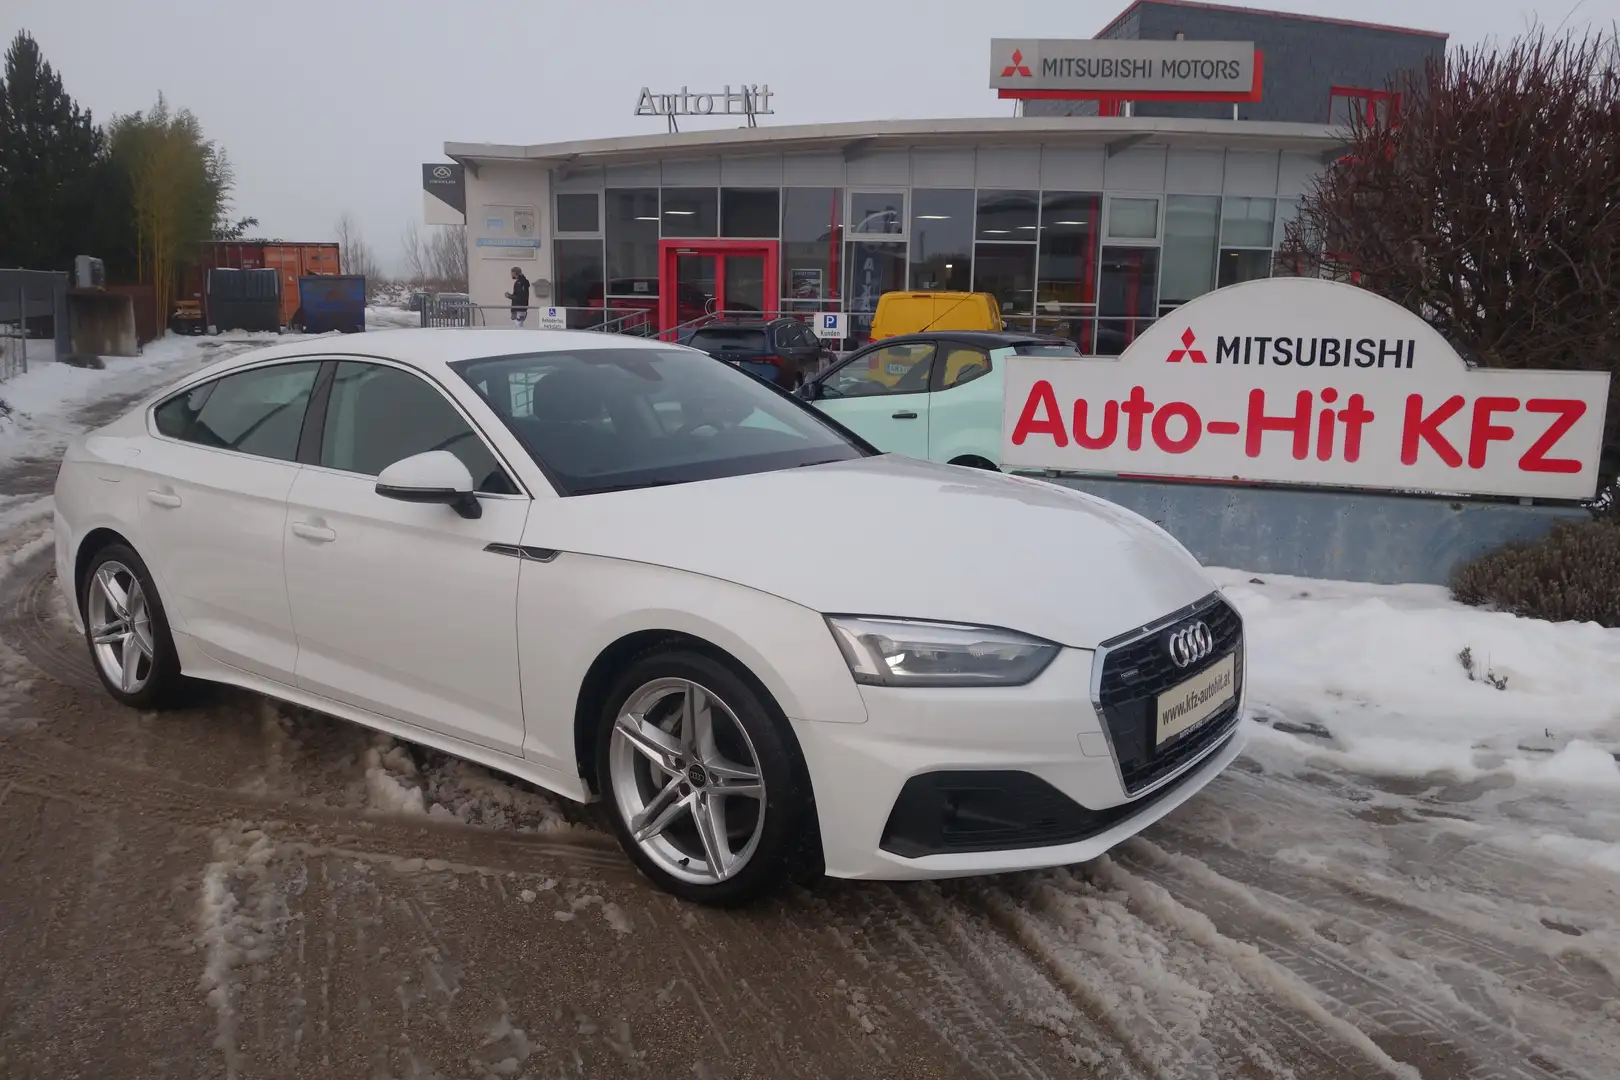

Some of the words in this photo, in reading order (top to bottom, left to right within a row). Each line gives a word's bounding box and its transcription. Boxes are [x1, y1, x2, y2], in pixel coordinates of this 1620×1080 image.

[1042, 56, 1153, 79] MITSUBISHI
[1161, 59, 1241, 80] MOTORS
[633, 86, 714, 115] Auto
[724, 83, 775, 115] Hit
[820, 329, 841, 337] Kunden
[825, 315, 835, 328] P
[1216, 335, 1416, 369] MITSUBISHI
[1012, 380, 1375, 463] Auto-Hit
[1401, 393, 1588, 474] KFZ
[1162, 668, 1230, 725] www.kfz-autohit.at
